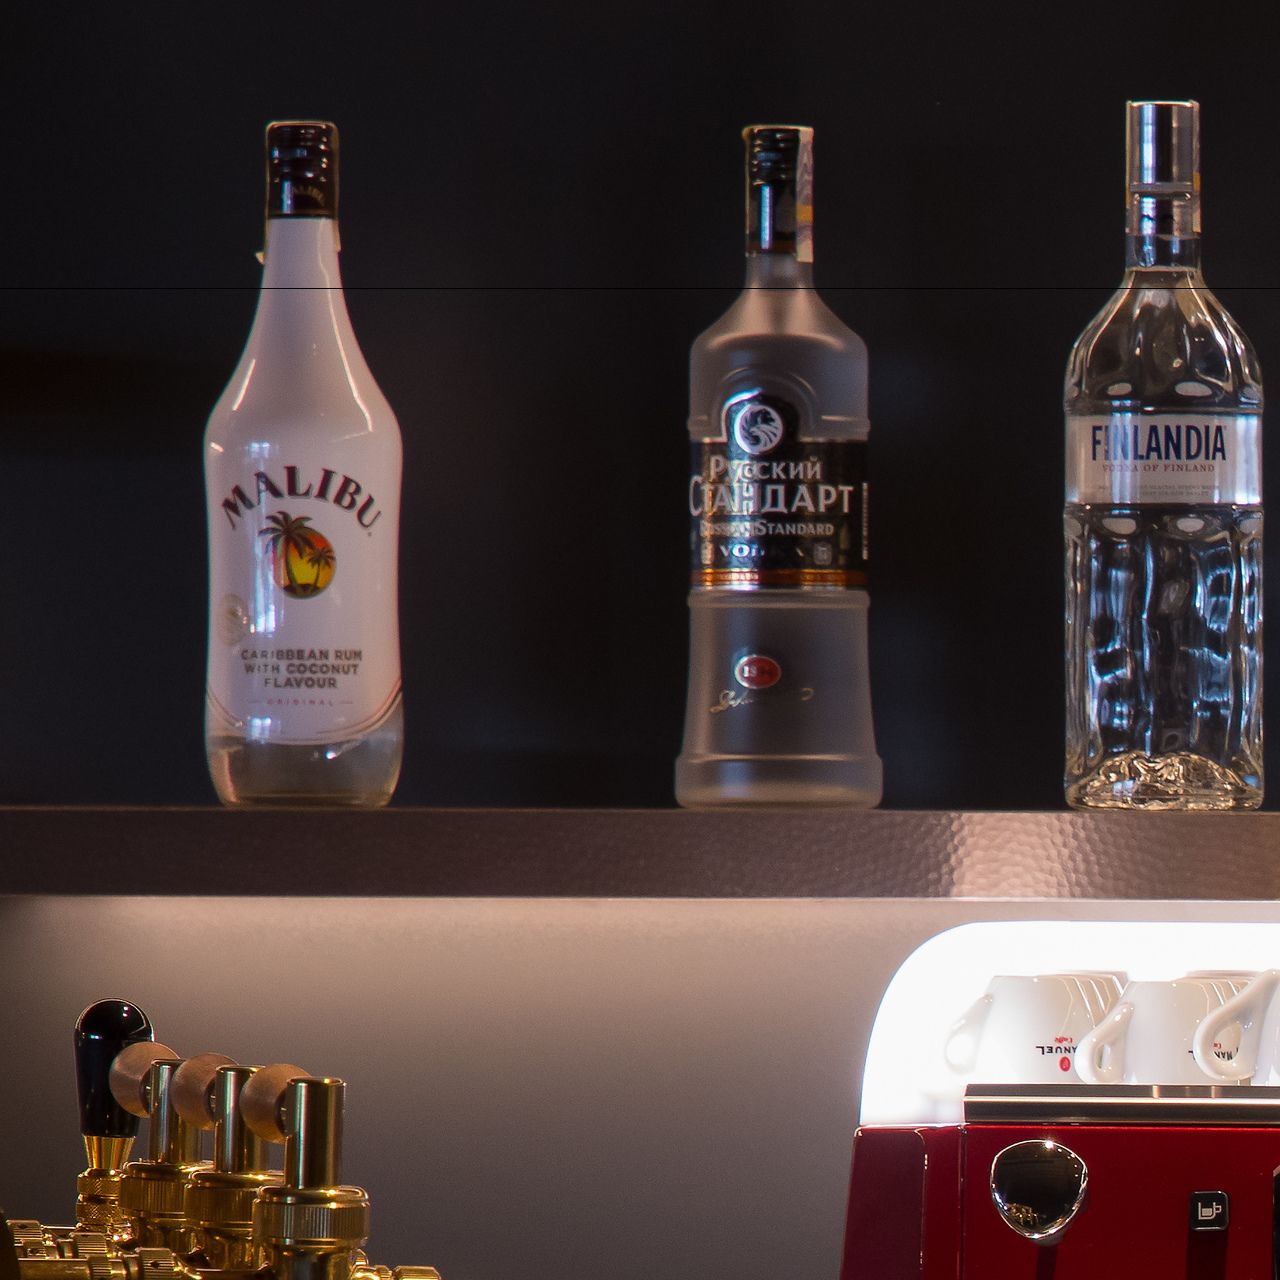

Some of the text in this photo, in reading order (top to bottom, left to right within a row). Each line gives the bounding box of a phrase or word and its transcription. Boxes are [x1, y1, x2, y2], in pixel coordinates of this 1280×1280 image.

[1091, 424, 1227, 461] FINLANDIA
[1144, 464, 1159, 473] OF
[1164, 464, 1216, 473] FINLAND
[222, 465, 382, 531] MALIBU
[241, 650, 362, 661] CARIBBEAN RUM
[245, 663, 359, 675] WITH COCONUT
[264, 677, 338, 689] FLAVOUR
[1035, 1045, 1079, 1056] ANUEL
